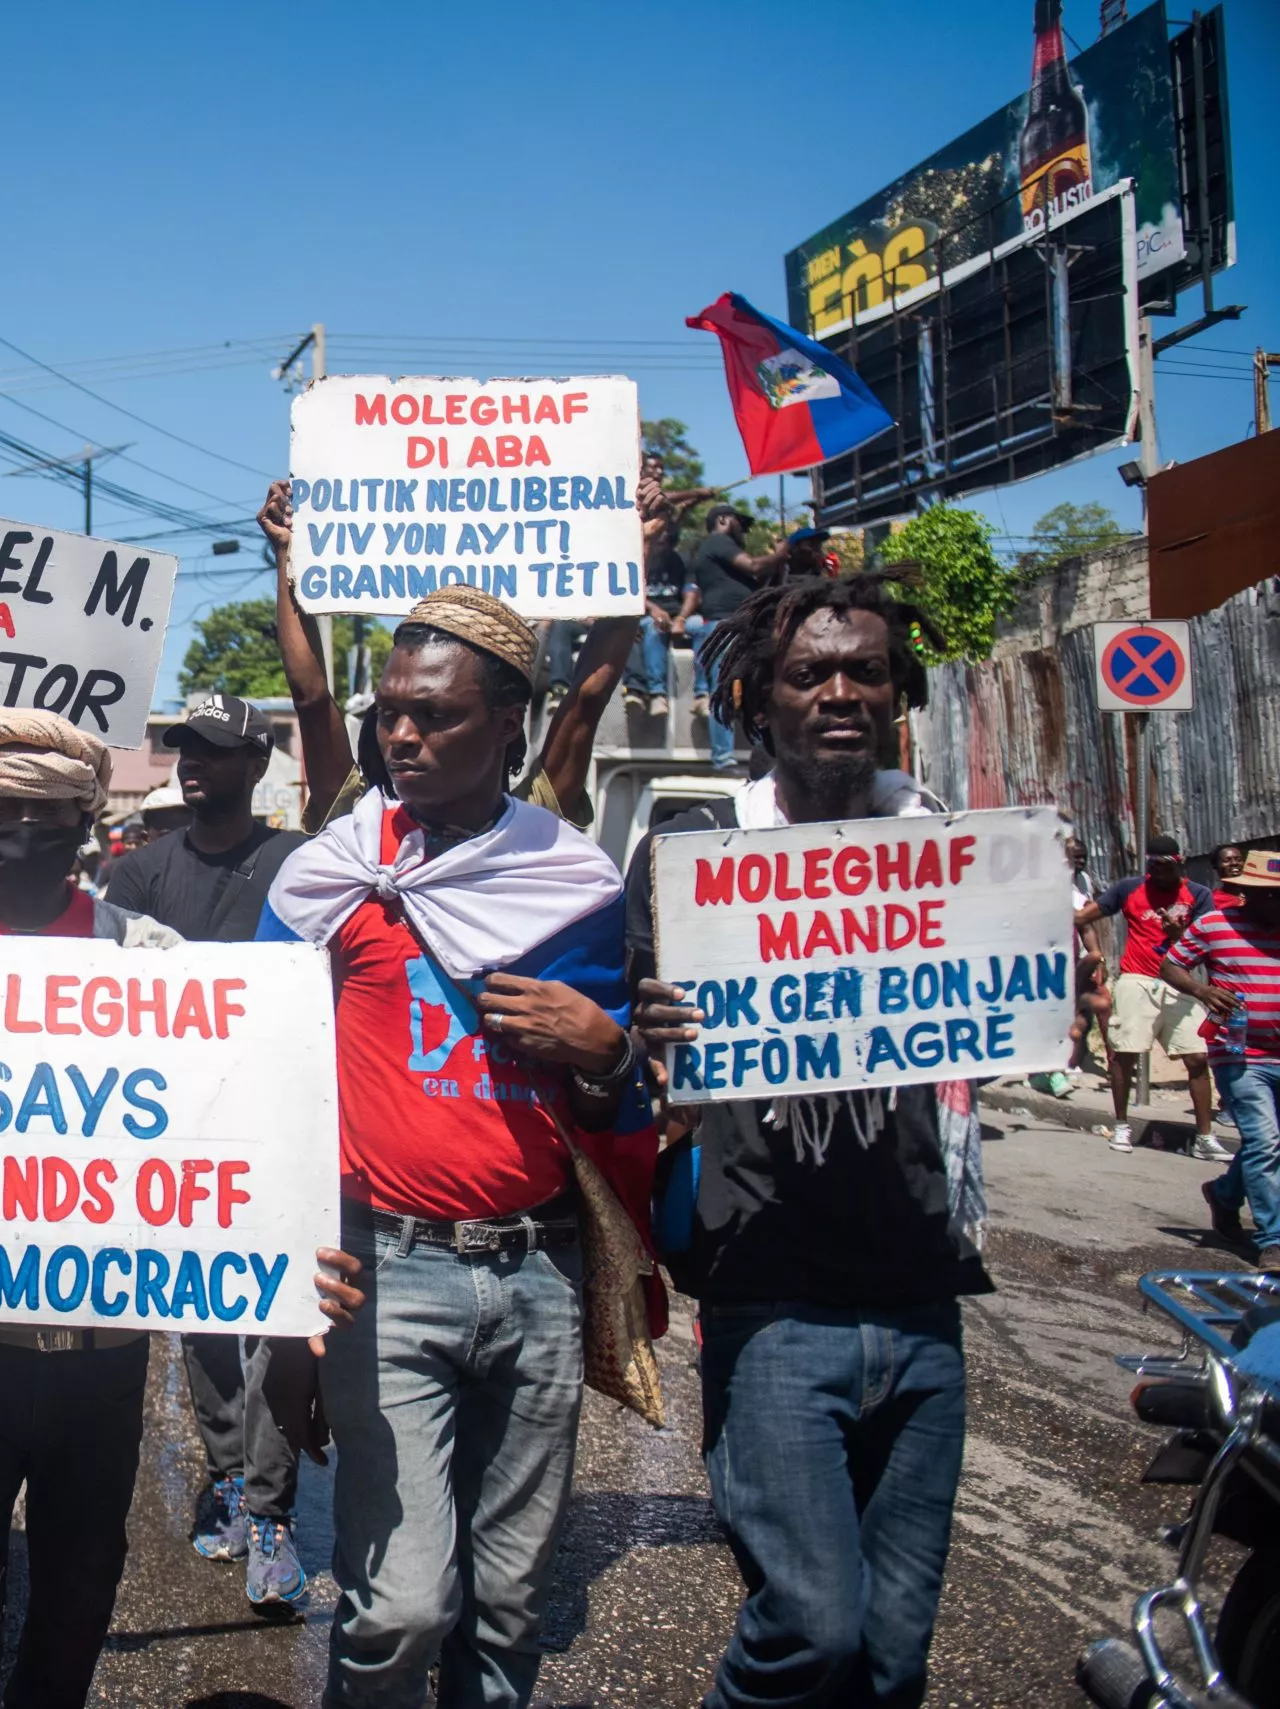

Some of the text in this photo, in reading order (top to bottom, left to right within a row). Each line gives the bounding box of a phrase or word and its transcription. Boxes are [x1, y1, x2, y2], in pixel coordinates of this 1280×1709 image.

[355, 392, 588, 426] MOLEGHAF
[406, 434, 551, 469] DI ABA
[289, 475, 636, 513] POLITIK NEOLIBERAL
[308, 518, 570, 556] VIV YON AYITI
[83, 550, 154, 632] M.
[608, 561, 640, 596] LI
[695, 835, 977, 907] MOLEGHAF
[759, 900, 946, 963] MANDE
[771, 967, 862, 1022] GEN
[423, 1077, 460, 1098] en
[136, 1158, 251, 1228] OFF
